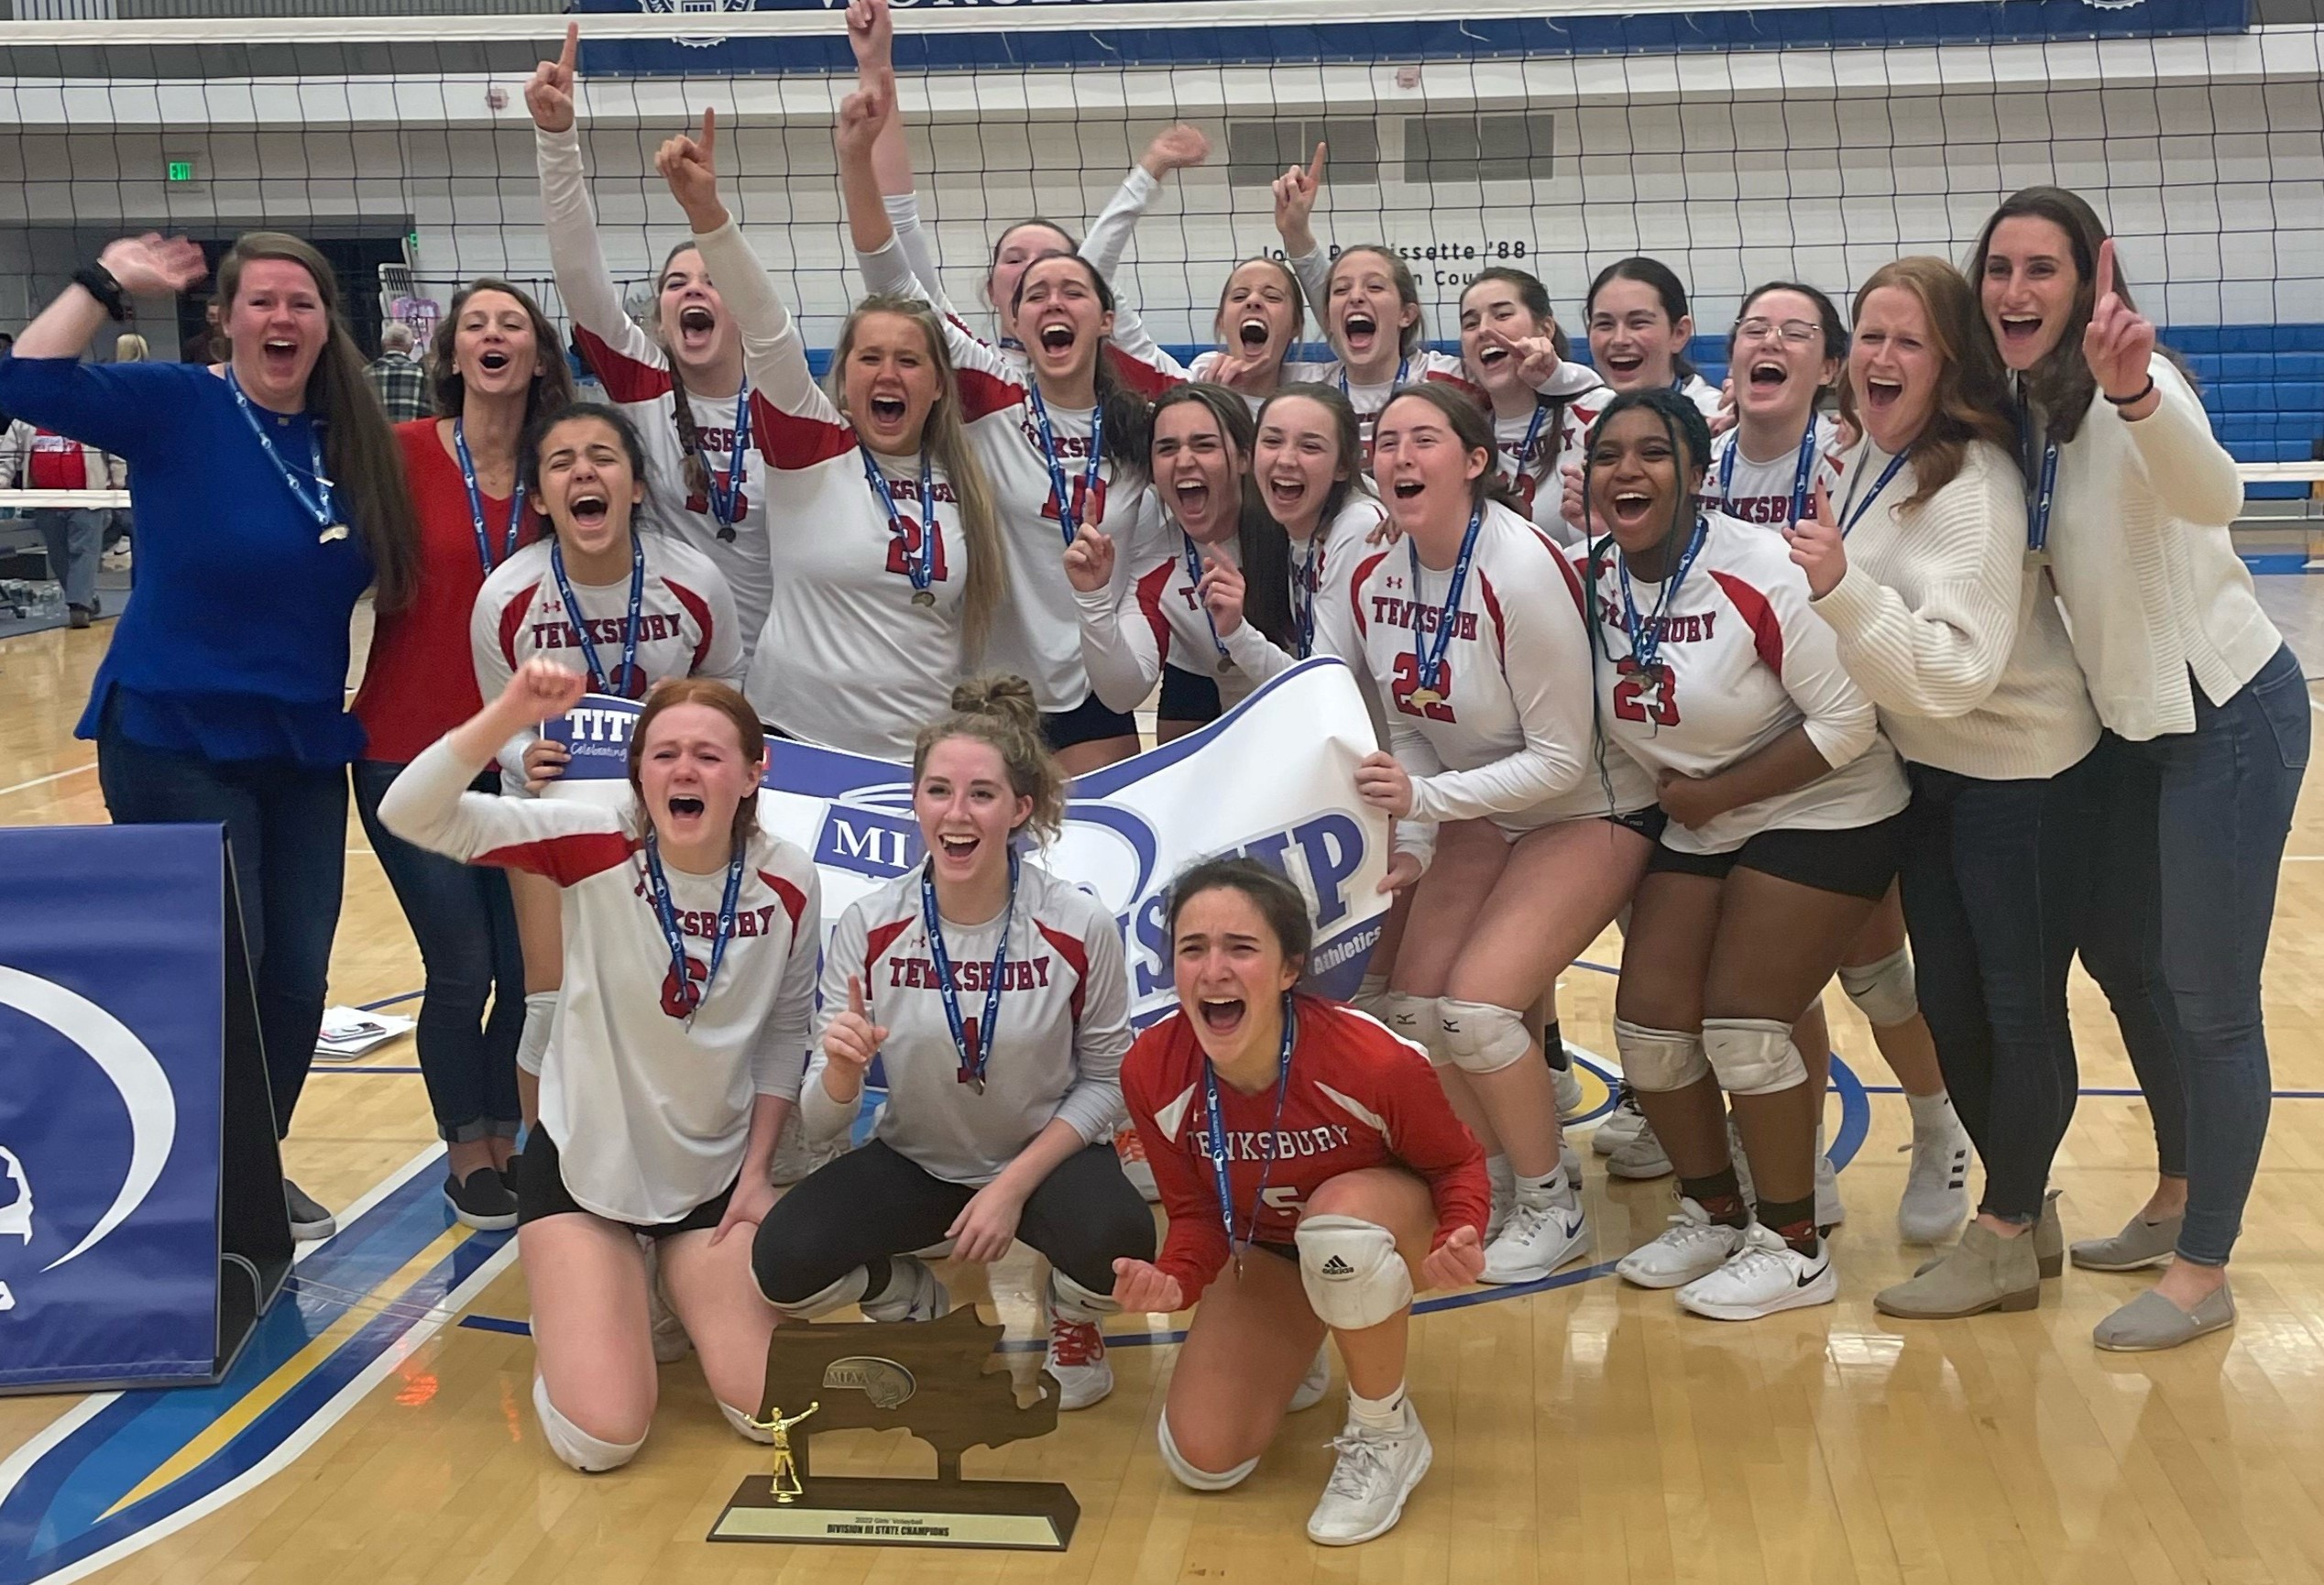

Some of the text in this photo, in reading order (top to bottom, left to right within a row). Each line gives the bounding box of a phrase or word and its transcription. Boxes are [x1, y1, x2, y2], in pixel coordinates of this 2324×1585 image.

[1489, 241, 1526, 259] '88
[885, 515, 948, 582] 21
[1391, 651, 1457, 724] 22
[1614, 654, 1681, 727] 23
[570, 742, 628, 762] Celebrating
[1313, 924, 1382, 976] Athletics
[660, 955, 707, 1019] 6
[828, 1371, 870, 1383] MIAA
[828, 1524, 862, 1534] DIVISION
[875, 1525, 898, 1535] STATE
[901, 1526, 949, 1536] CHAMPIONS
